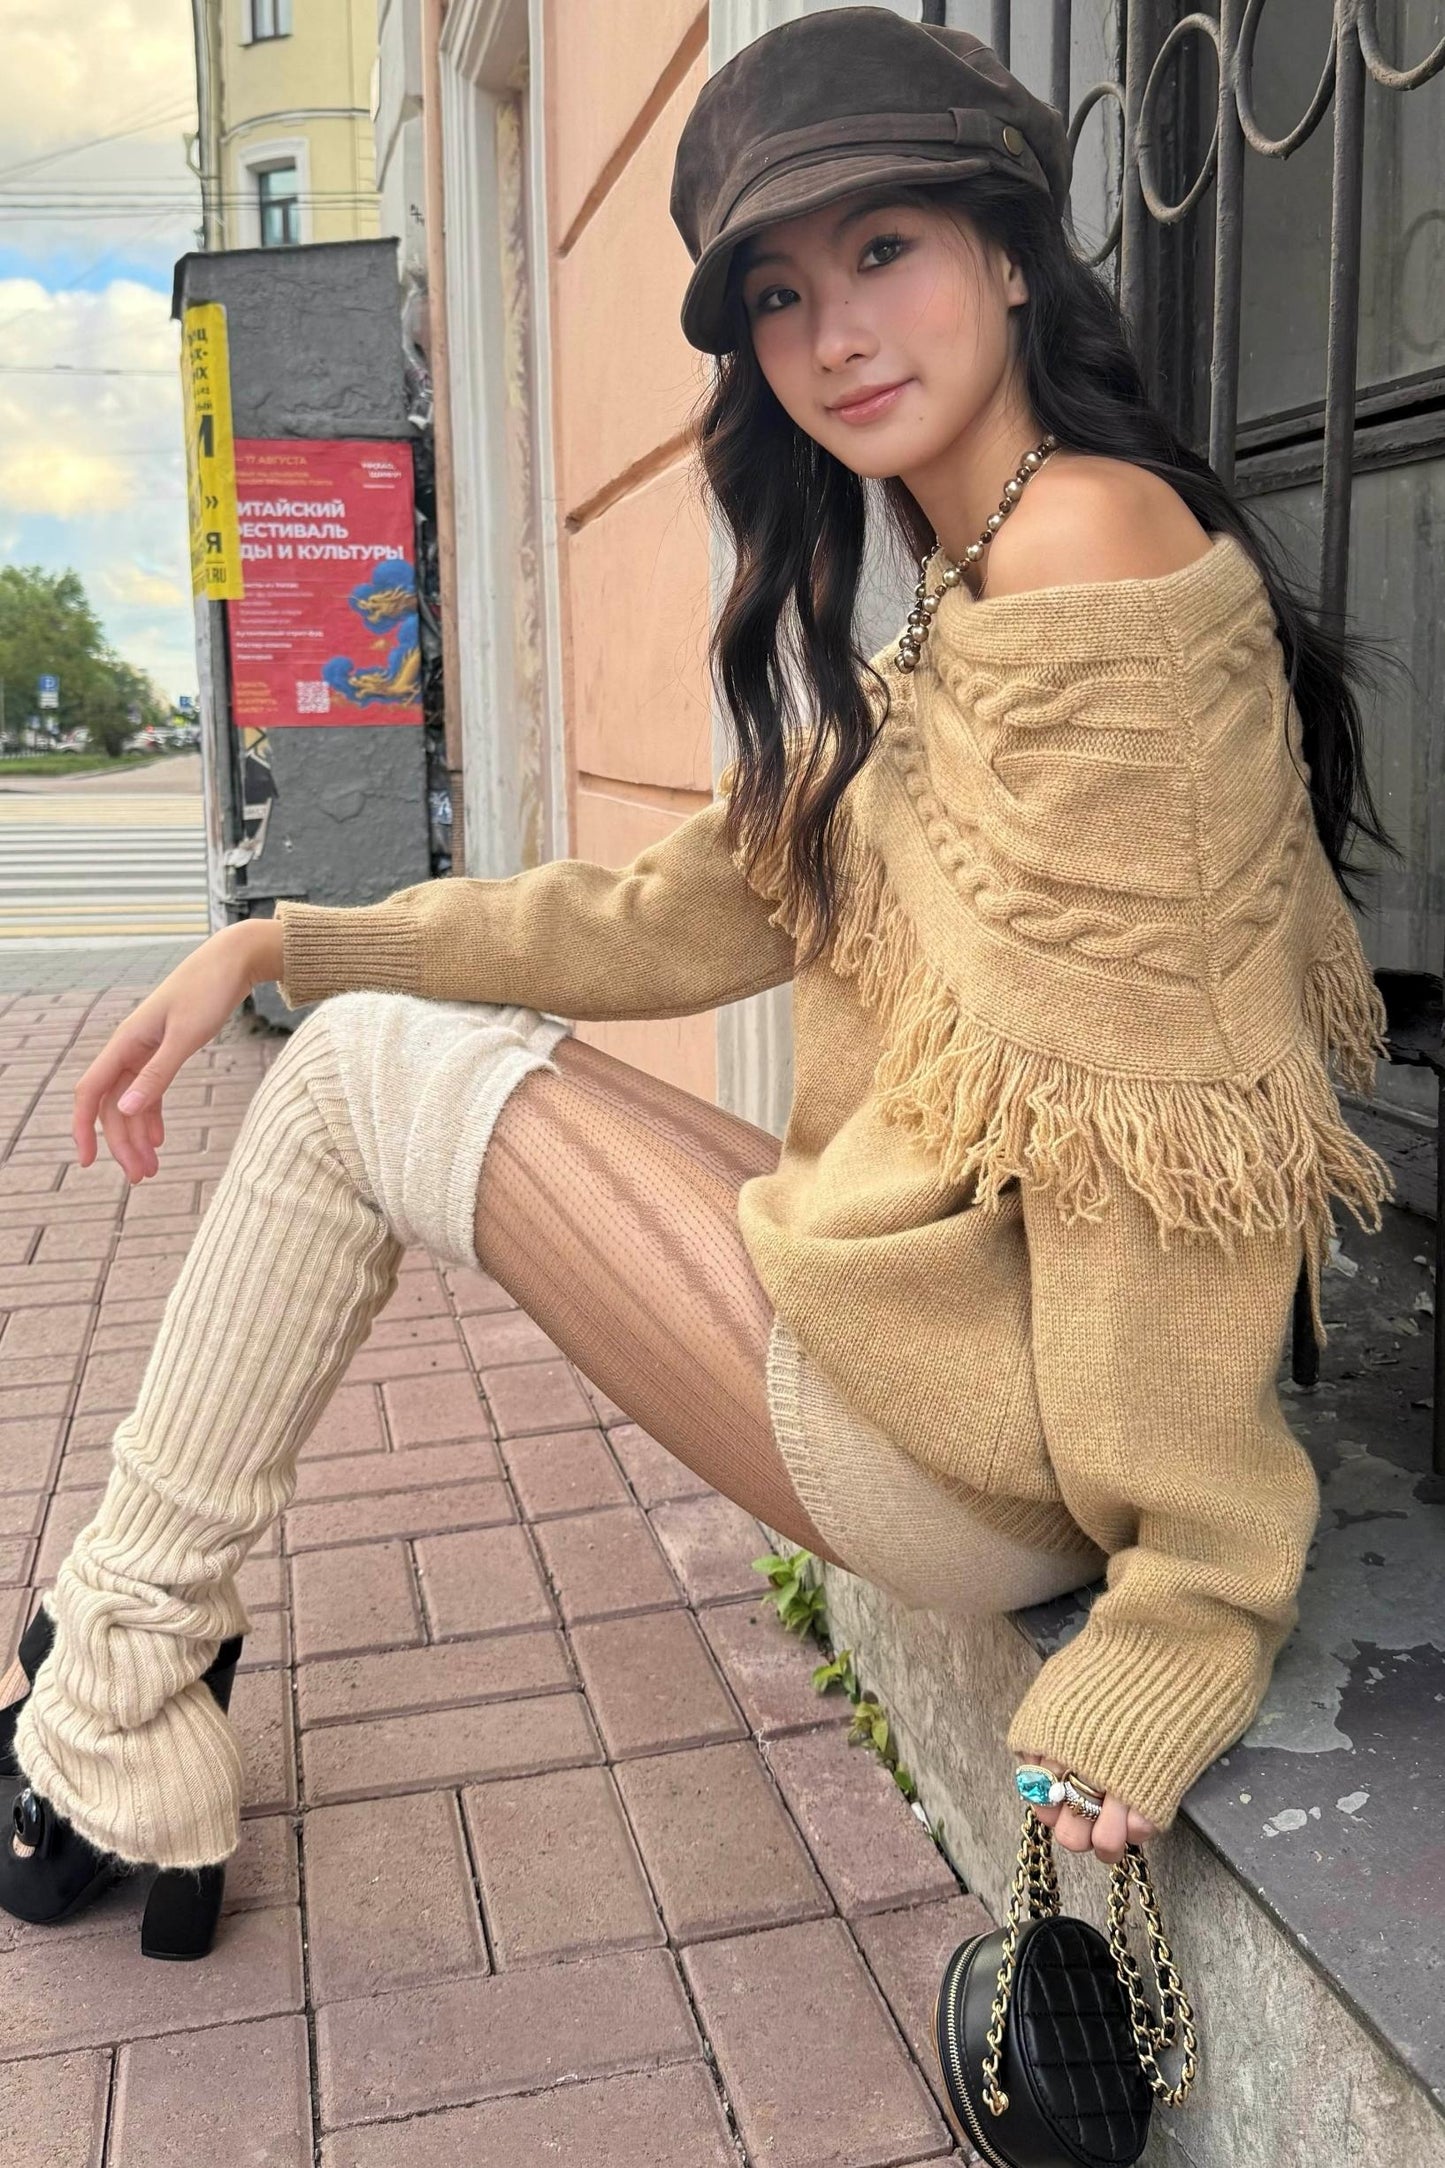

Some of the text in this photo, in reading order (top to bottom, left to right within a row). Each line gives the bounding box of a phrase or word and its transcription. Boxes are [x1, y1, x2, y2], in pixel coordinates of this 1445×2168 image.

[258, 456, 307, 465] АВГУСТА
[237, 498, 345, 518] ИТАЙСКИЙ
[206, 532, 222, 554] Я
[240, 545, 404, 561] ДЫ И КУЛЬТУРЫ
